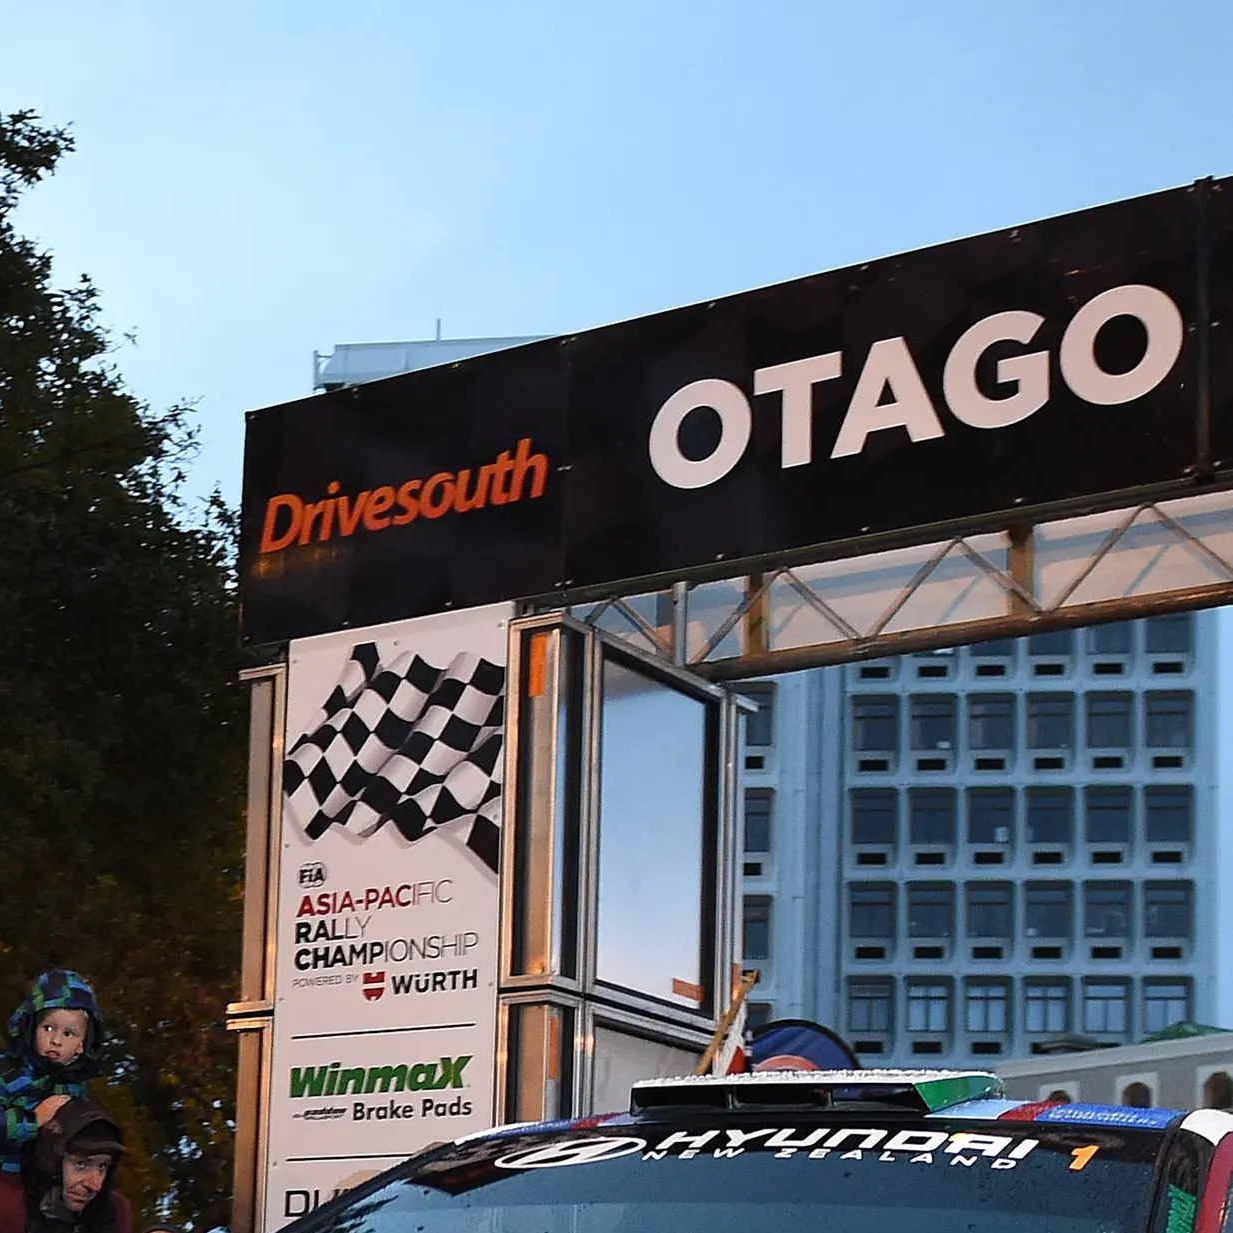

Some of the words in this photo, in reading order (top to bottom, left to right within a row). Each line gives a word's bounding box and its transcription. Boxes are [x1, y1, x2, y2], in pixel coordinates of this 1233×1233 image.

[648, 283, 1185, 490] OTAGO
[258, 437, 549, 554] Drivesouth
[296, 879, 453, 917] ASIA-PACIFIC
[295, 915, 371, 944] RALLY
[294, 932, 479, 970] CHAMPIONSHIP
[292, 974, 343, 987] POWERED
[346, 973, 359, 984] BY
[352, 1100, 414, 1121] Brake
[422, 1096, 473, 1117] Pads
[655, 1127, 1039, 1160] HYUNDAI
[1069, 1144, 1100, 1171] 1
[641, 1149, 746, 1161] NEW
[774, 1149, 1018, 1170] ZEALAND
